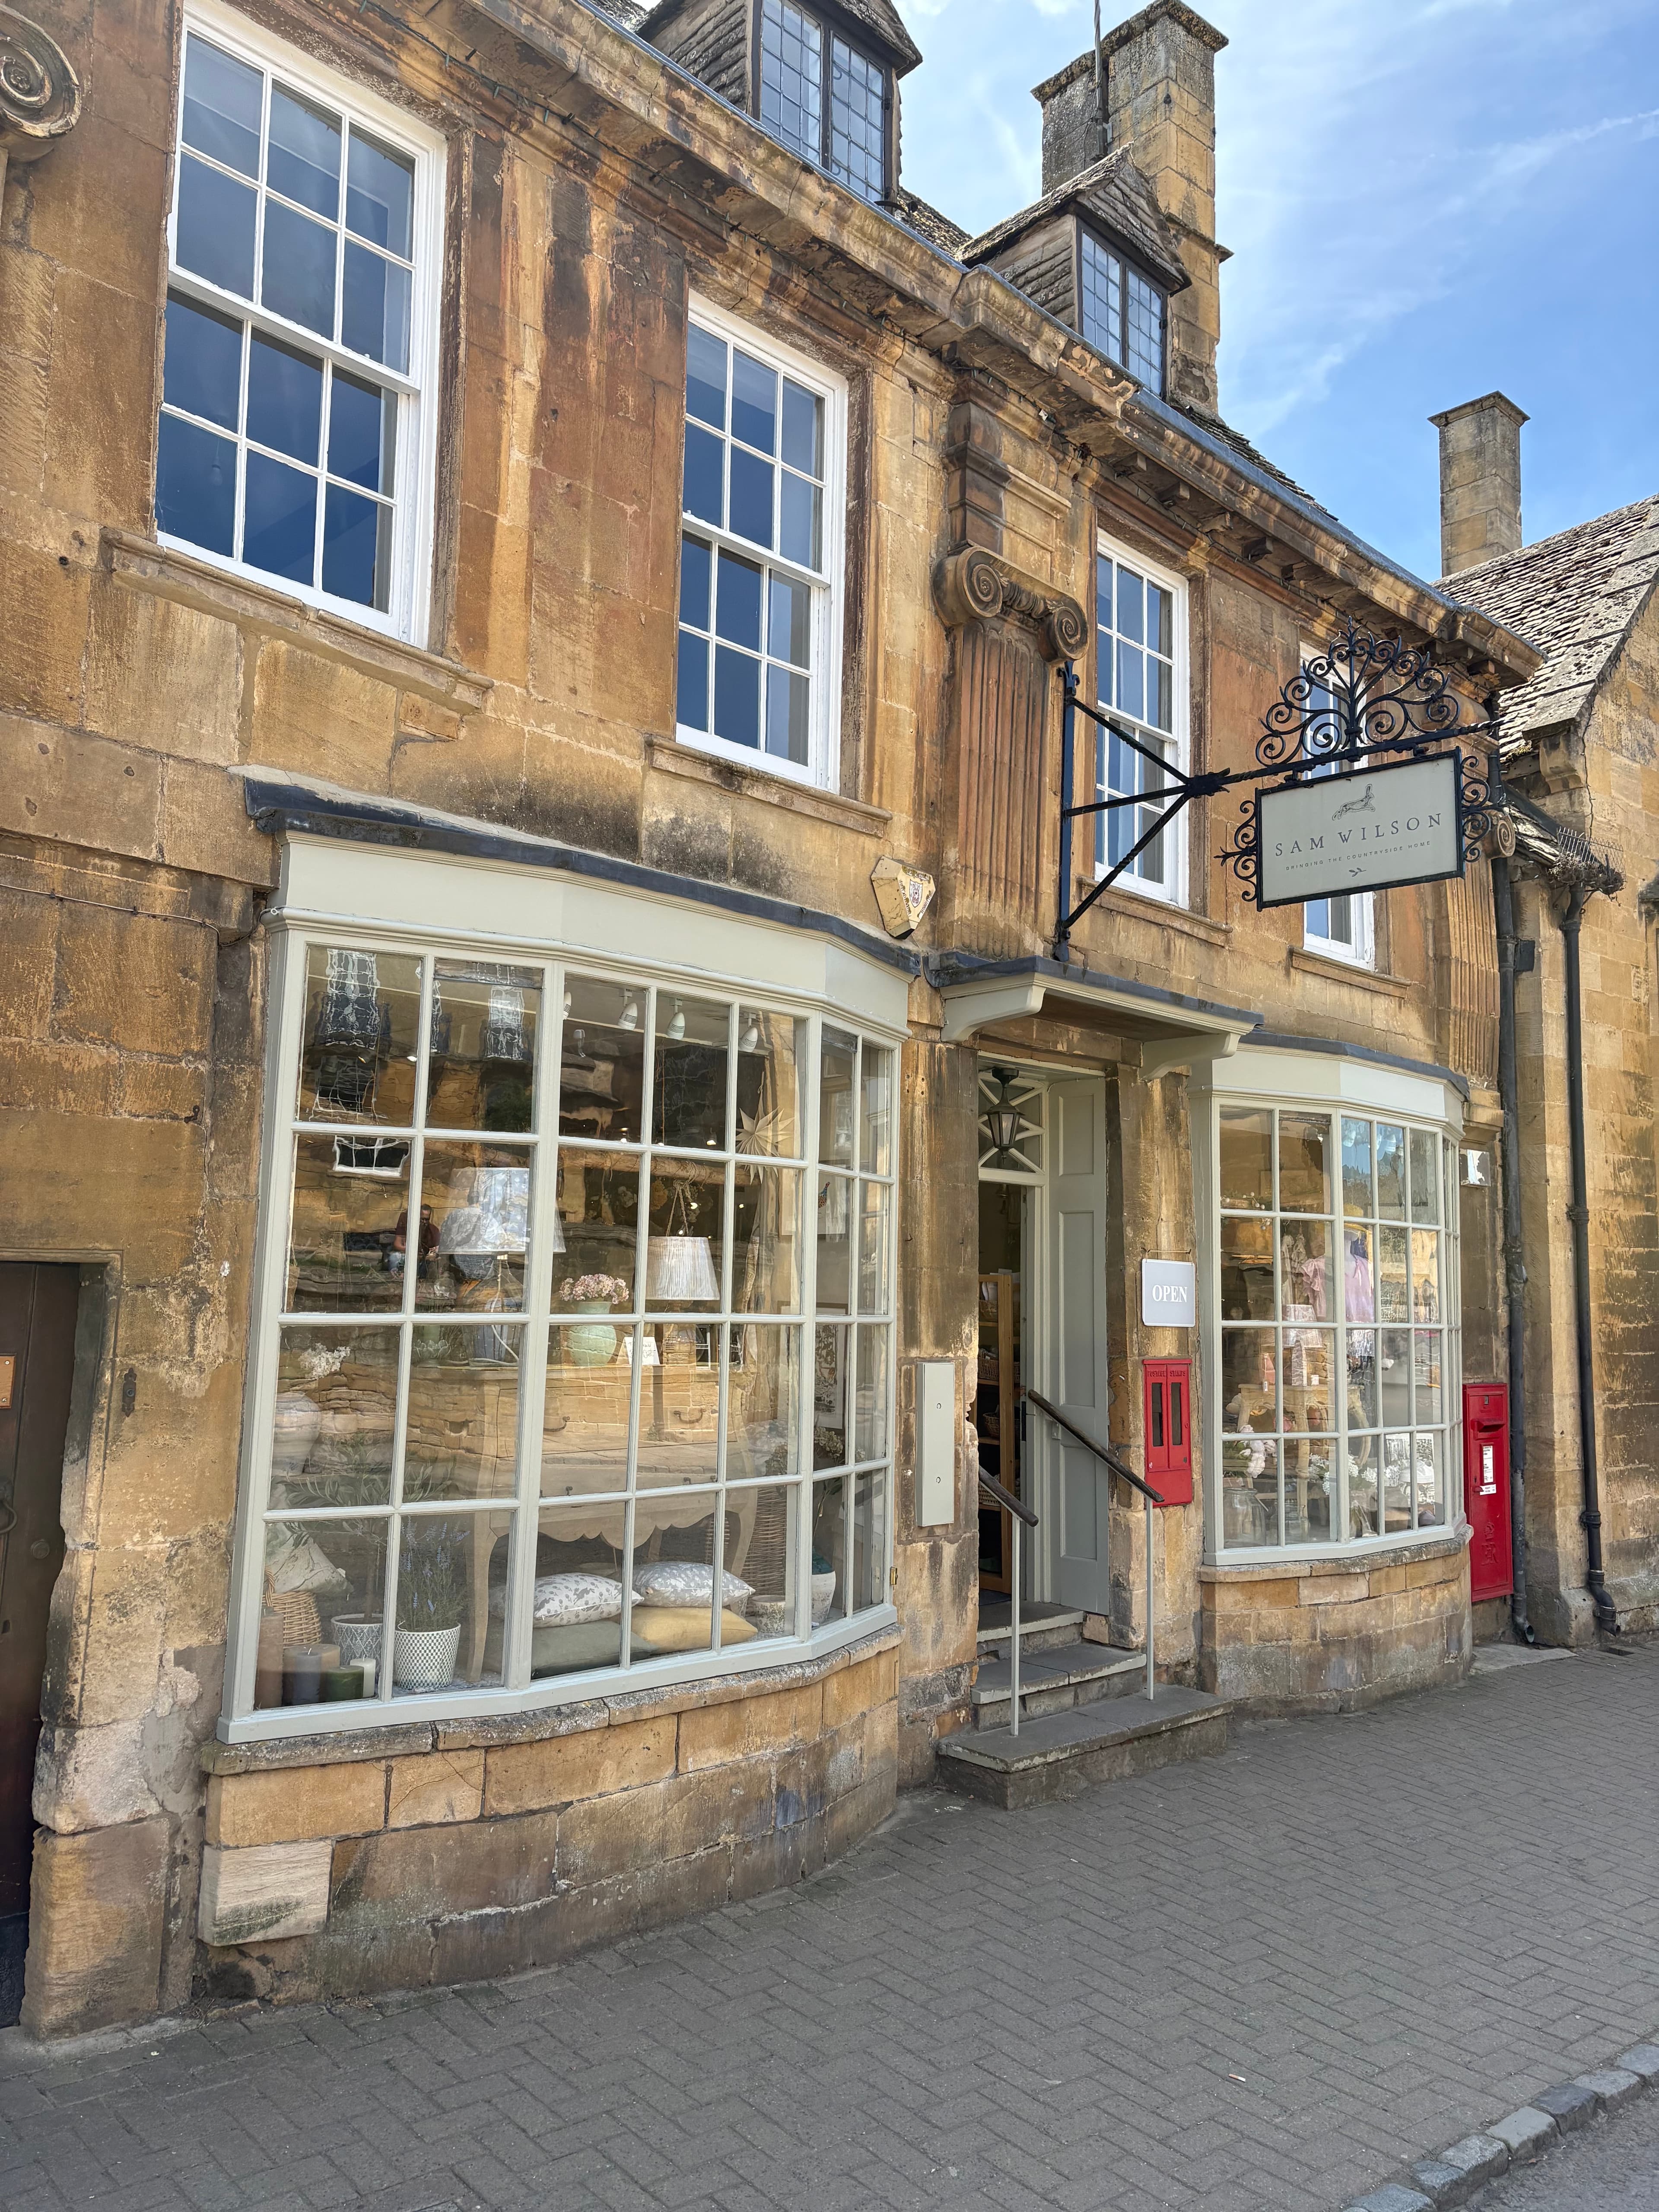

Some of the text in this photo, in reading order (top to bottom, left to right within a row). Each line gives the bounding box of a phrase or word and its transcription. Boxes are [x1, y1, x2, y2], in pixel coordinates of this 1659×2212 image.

[1275, 813, 1442, 856] SAM WILSON
[1286, 860, 1324, 871] BRINGING
[1346, 845, 1403, 860] COUNTRYSIDE
[1408, 840, 1431, 849] HOME
[1152, 1285, 1187, 1303] OPEN
